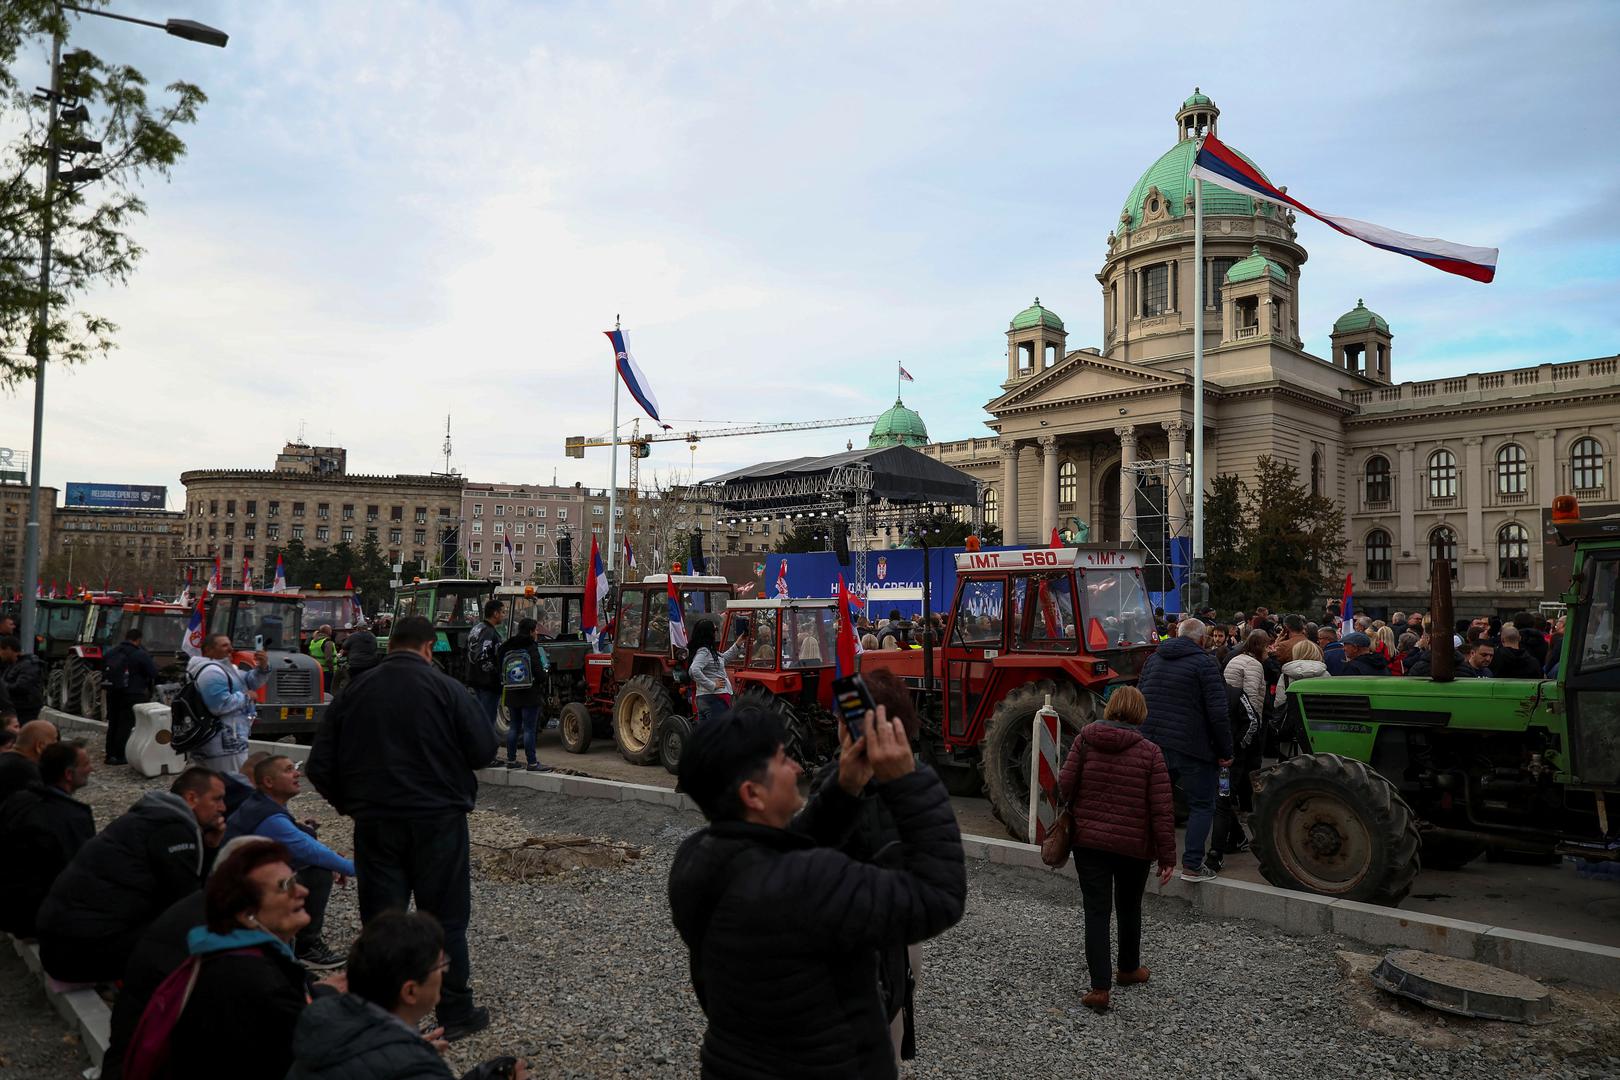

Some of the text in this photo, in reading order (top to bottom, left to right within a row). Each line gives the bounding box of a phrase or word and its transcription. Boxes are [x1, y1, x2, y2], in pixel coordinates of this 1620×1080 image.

[970, 551, 1058, 568] IMT 560
[1097, 552, 1117, 565] IMT
